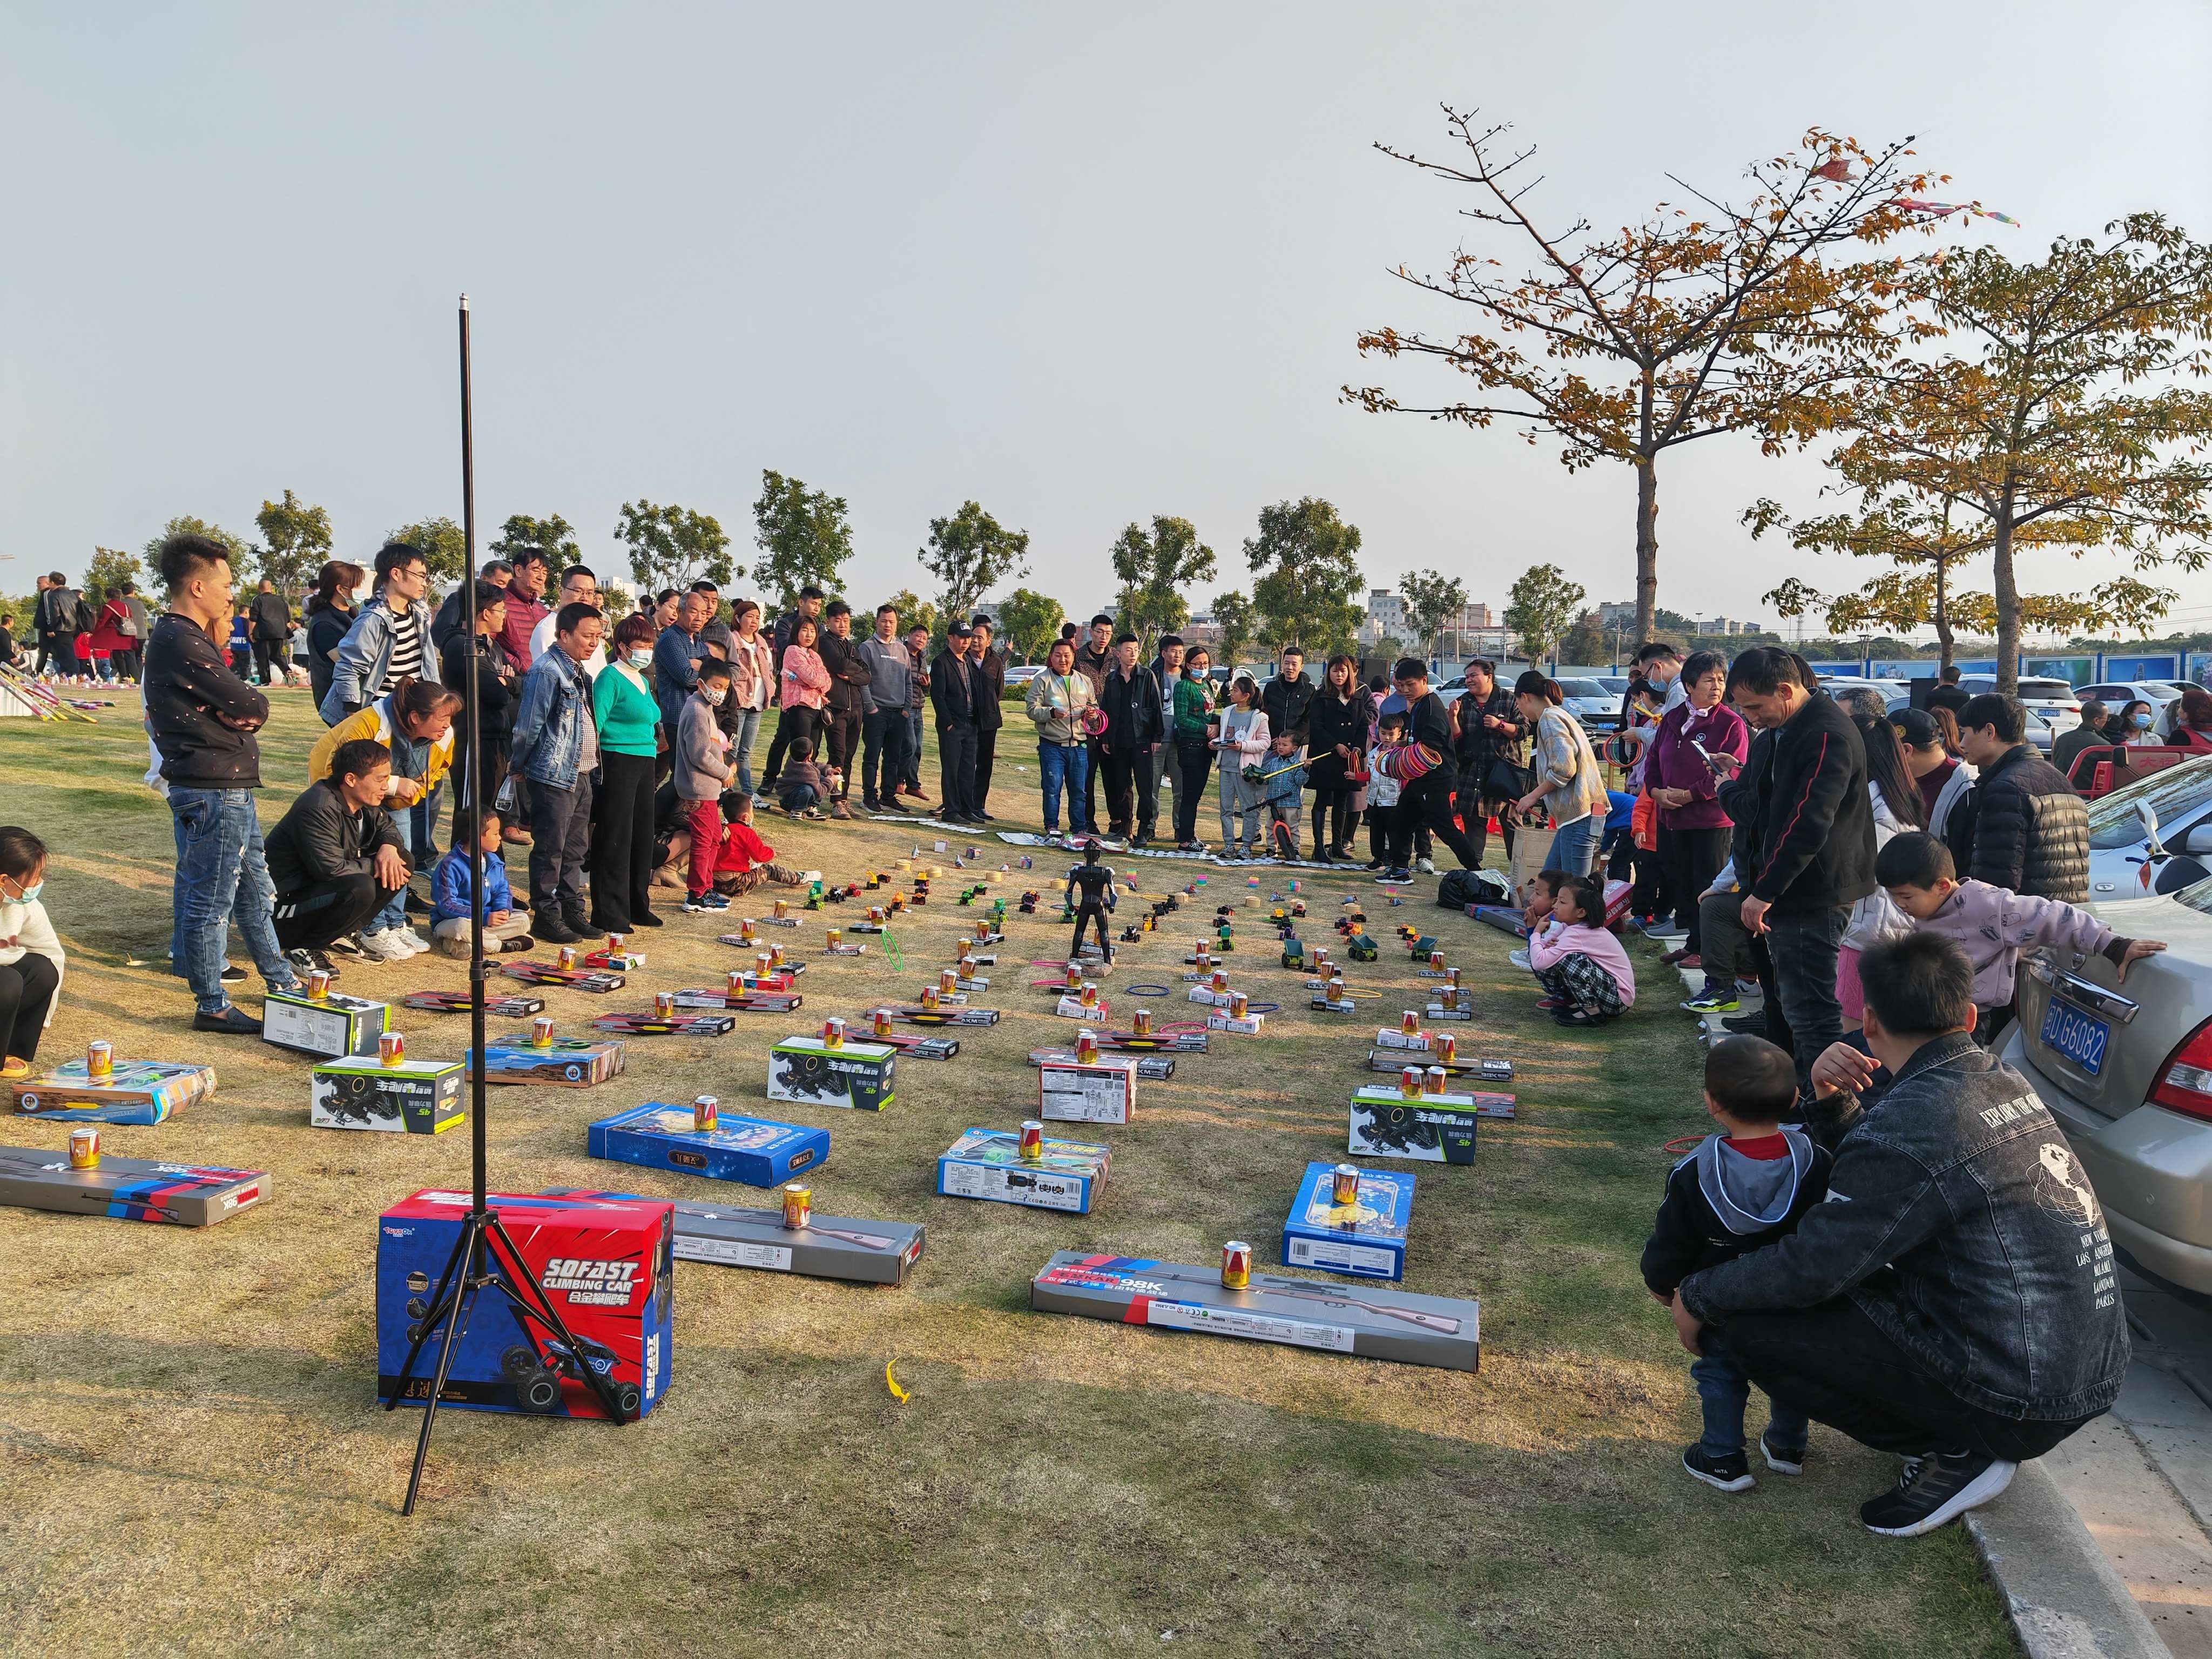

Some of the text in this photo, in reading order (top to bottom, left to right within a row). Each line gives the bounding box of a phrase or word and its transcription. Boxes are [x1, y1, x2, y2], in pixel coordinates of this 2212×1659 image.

[230, 636, 247, 644] WAYS
[2139, 756, 2176, 769] 大运
[2060, 1013, 2105, 1066] G6082
[1978, 1102, 2021, 1129] EXPLORE
[2012, 1097, 2033, 1115] THE
[2080, 1228, 2108, 1248] NEW YORK
[2075, 1251, 2090, 1267] LOS
[544, 1258, 639, 1280] SOFAST
[2094, 1259, 2112, 1277] MIAMI
[542, 1278, 633, 1293] CLIMBING CAR
[1046, 1276, 1100, 1287] 双模式子弹
[1120, 1278, 1165, 1291] 98K
[2093, 1276, 2115, 1294] LONDON
[569, 1291, 630, 1305] 合金攀爬车
[1104, 1284, 1168, 1296] 自由转换战场
[2095, 1293, 2115, 1310] PARIS
[646, 1335, 655, 1399] SOFAST
